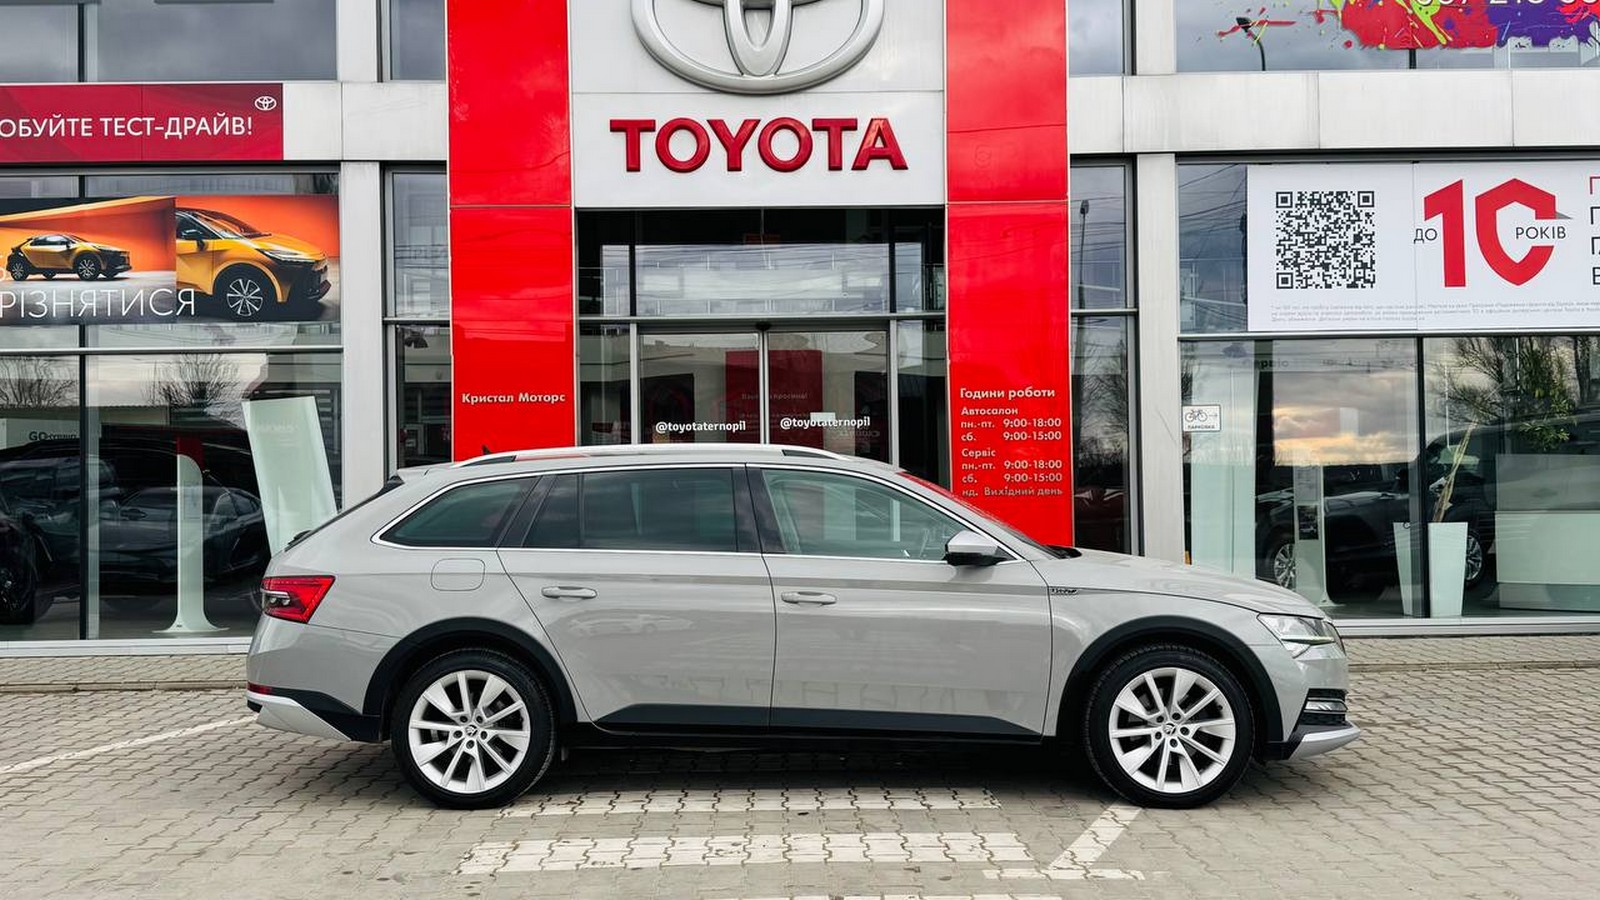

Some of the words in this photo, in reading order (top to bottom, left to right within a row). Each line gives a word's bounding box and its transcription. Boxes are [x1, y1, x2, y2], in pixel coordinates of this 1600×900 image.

[100, 111, 252, 140] ТЕСТ-ДРАЙВ!
[609, 117, 909, 173] TOYOTA
[1413, 224, 1438, 244] ДО
[1515, 225, 1567, 240] РОКІВ
[0, 288, 195, 319] РІЗНЯТИСЯ
[461, 392, 514, 406] Кристал
[518, 391, 566, 404] Моторс
[960, 388, 1005, 399] Години
[1008, 386, 1055, 400] роботи
[961, 407, 1018, 415] Автосалон
[655, 420, 746, 435] @toyotaternopil
[780, 415, 871, 431] @toyotaternopil
[961, 432, 976, 441] сб.
[962, 448, 996, 458] Сервіс
[962, 474, 977, 483] сб.
[985, 486, 1035, 496] Вихідний
